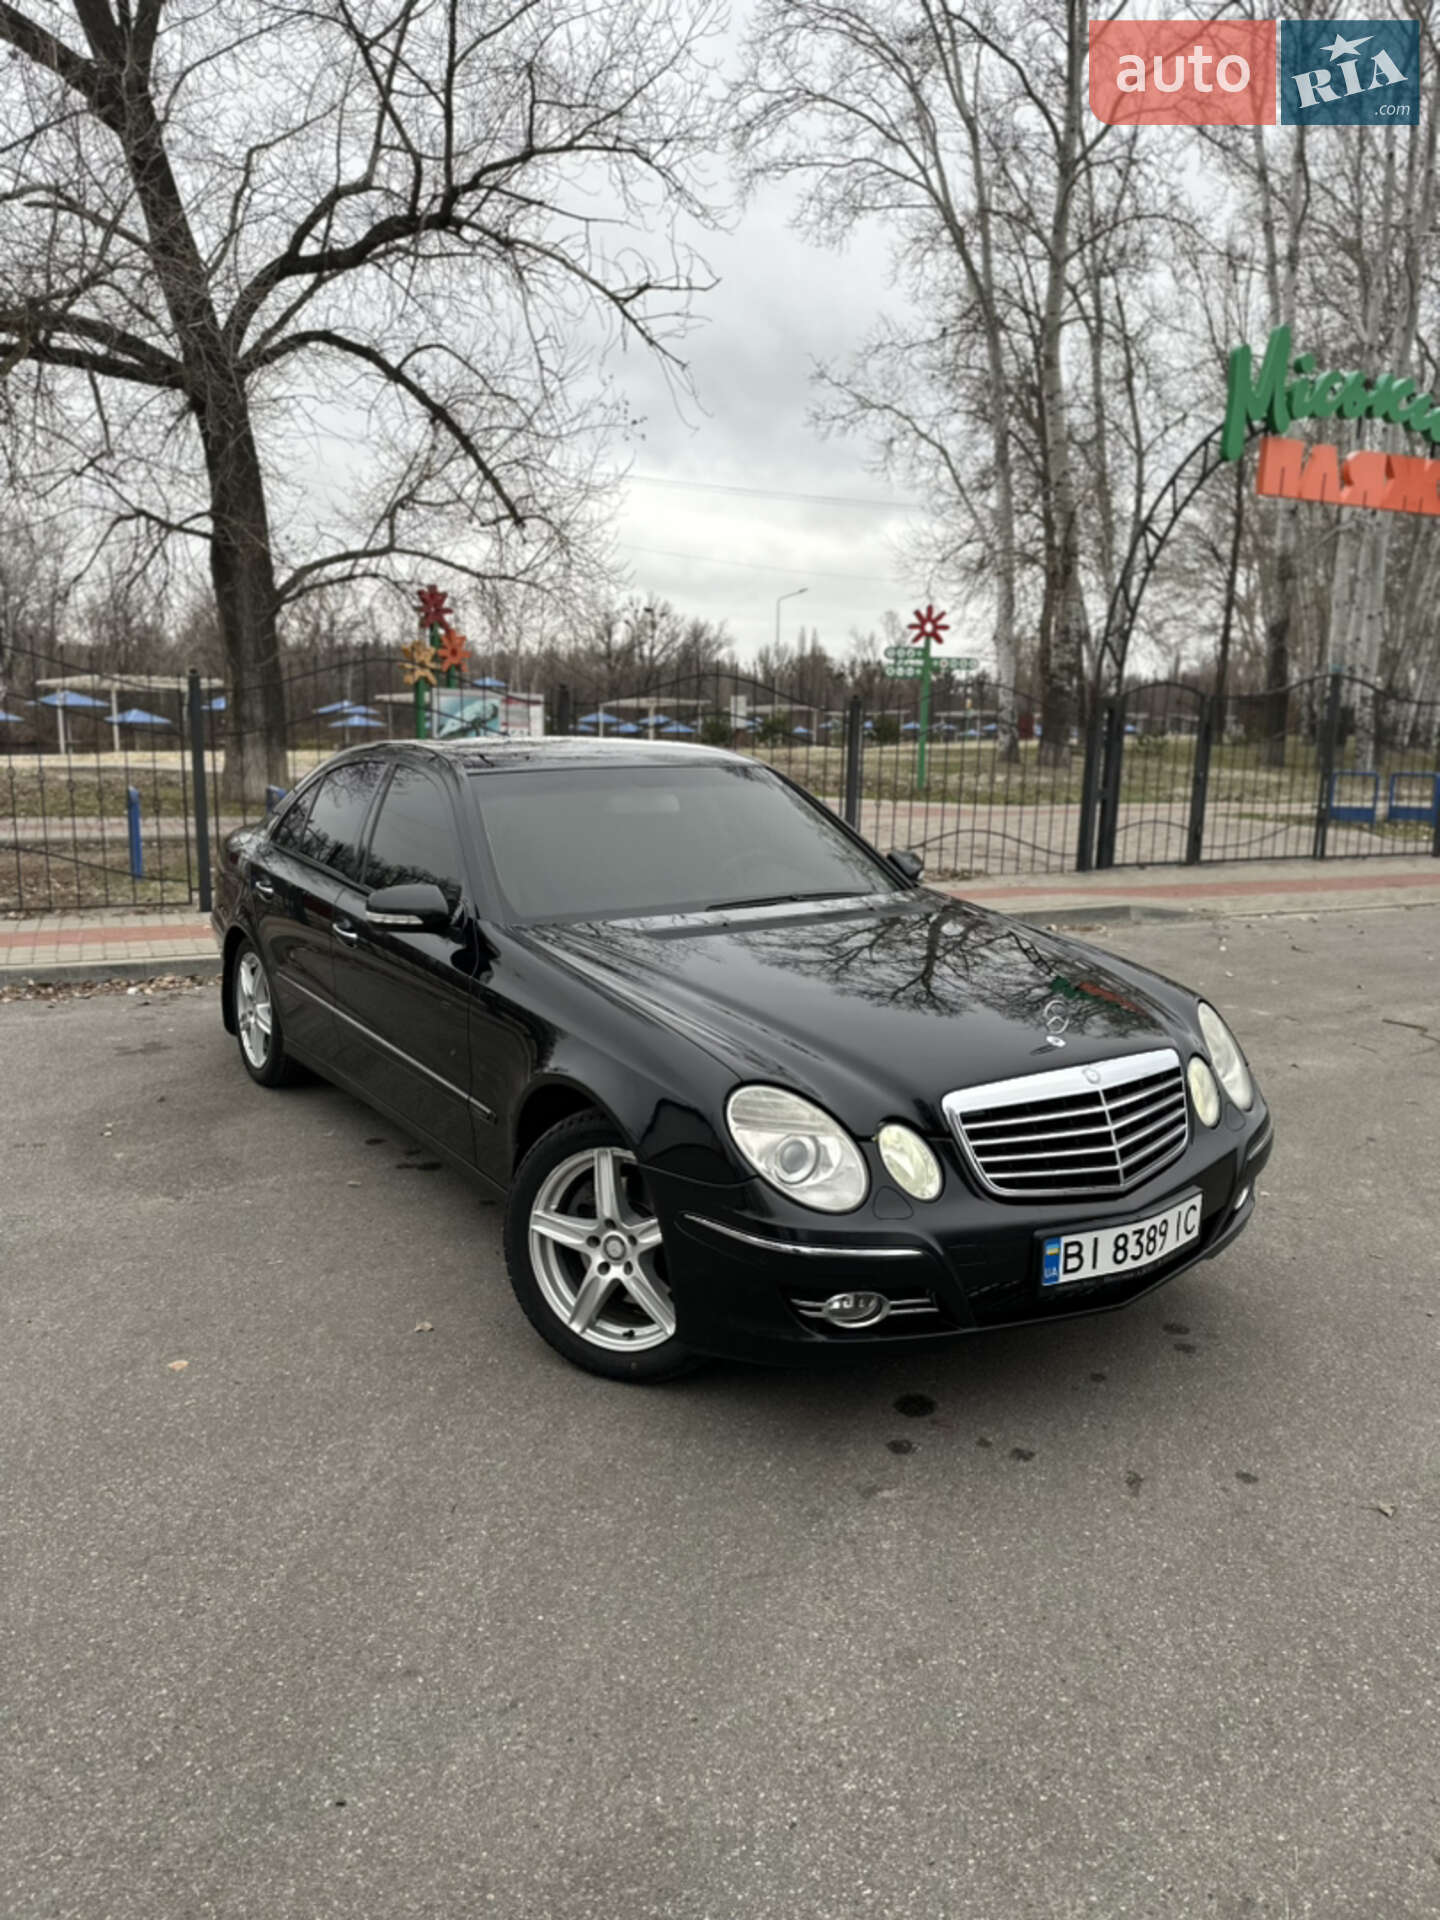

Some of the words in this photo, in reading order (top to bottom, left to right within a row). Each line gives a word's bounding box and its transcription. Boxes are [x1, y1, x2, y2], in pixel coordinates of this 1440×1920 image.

[1062, 1237, 1099, 1275] BI
[1112, 1219, 1168, 1264] 8389
[1176, 1204, 1198, 1241] IC
